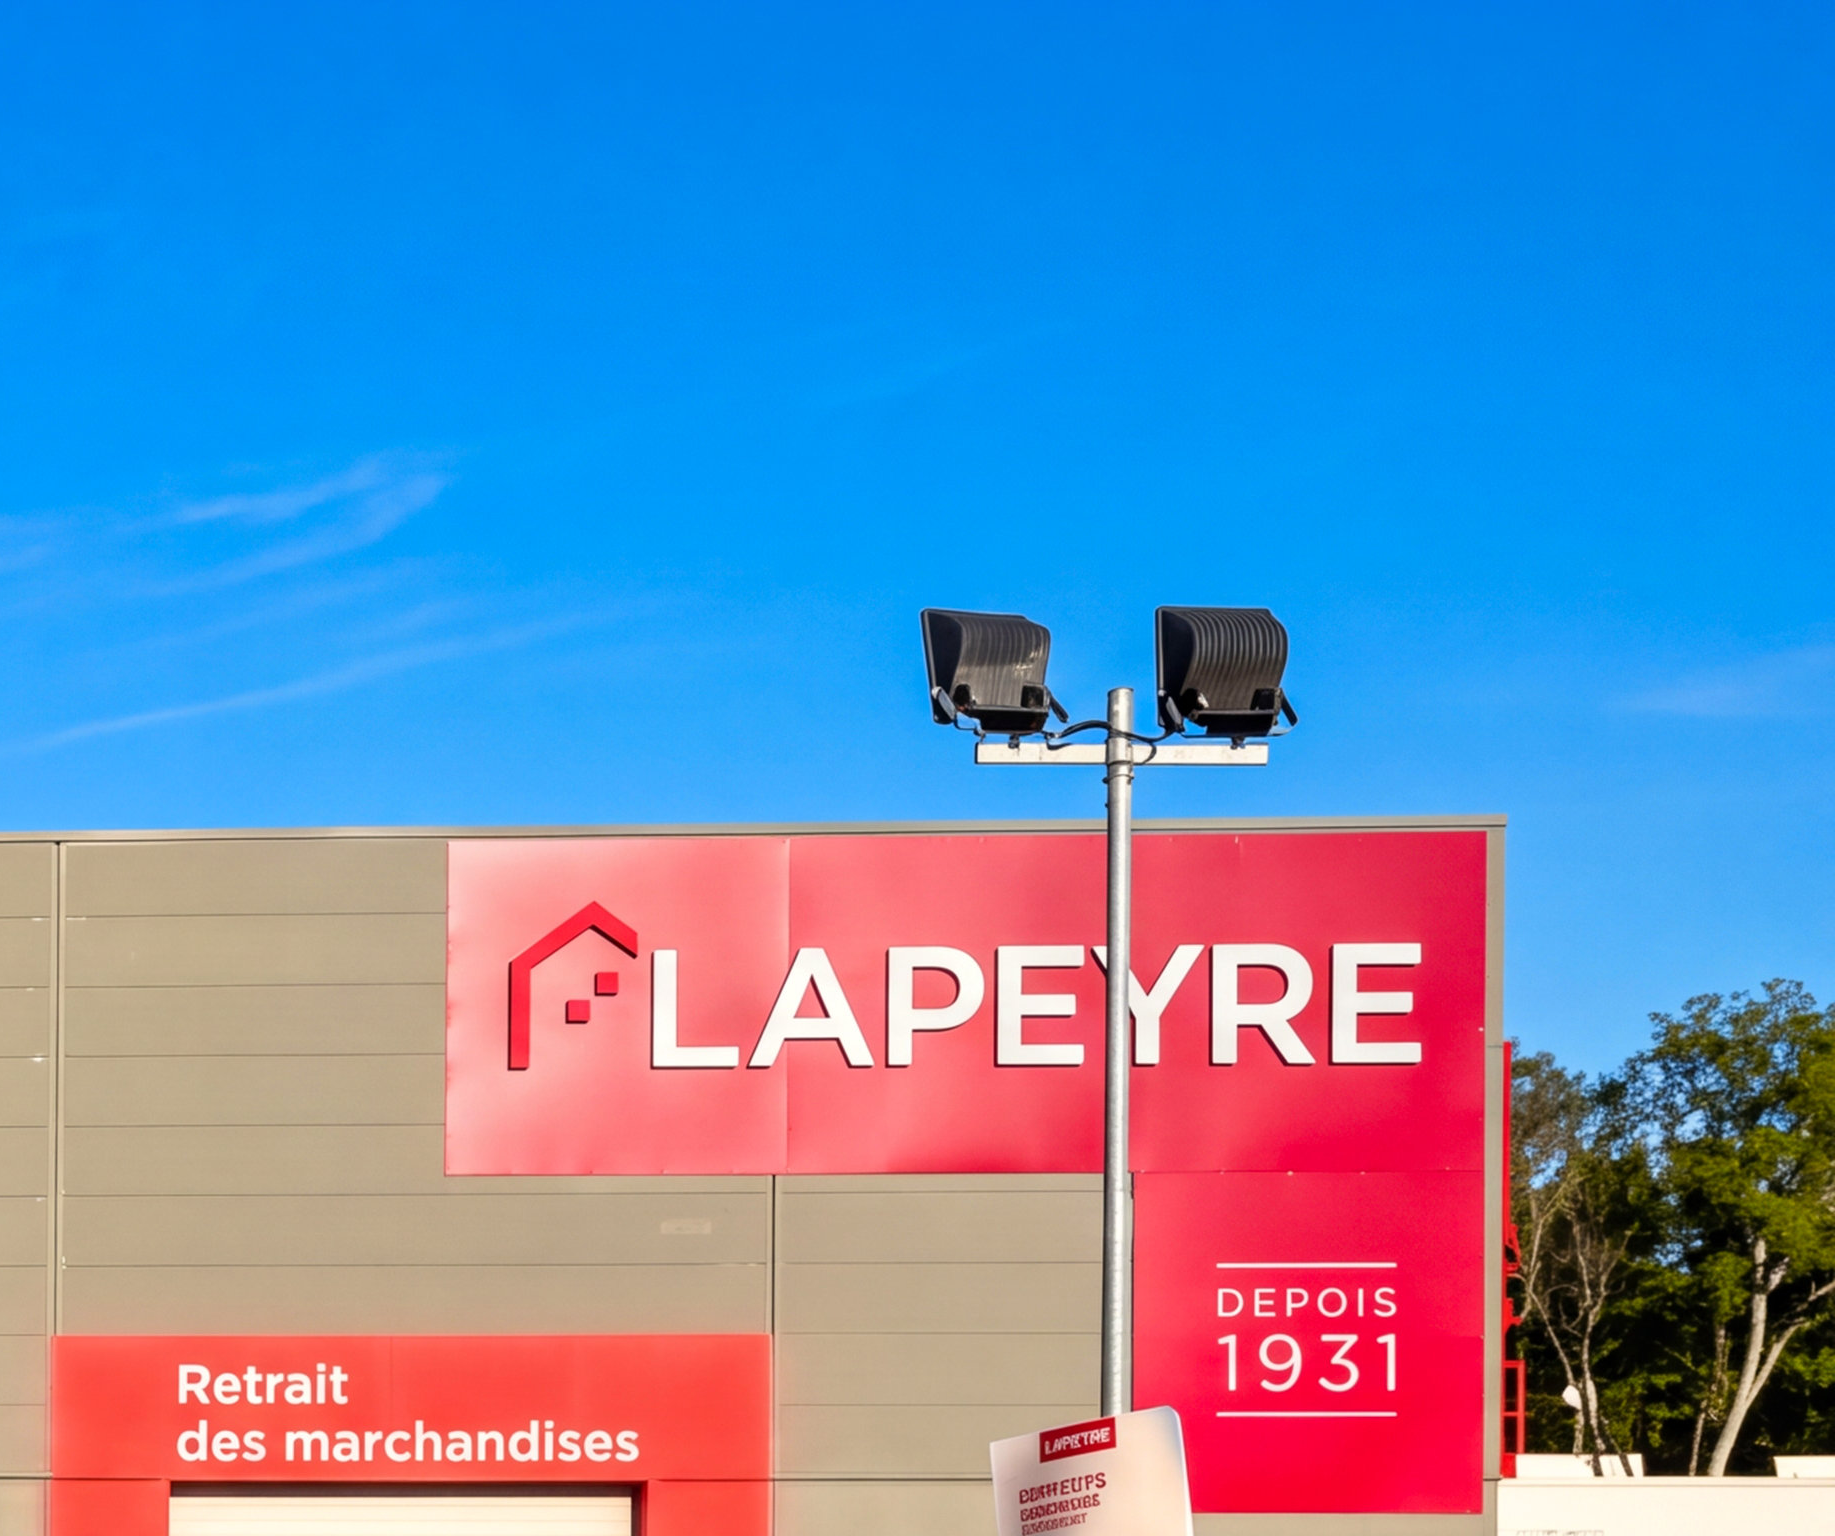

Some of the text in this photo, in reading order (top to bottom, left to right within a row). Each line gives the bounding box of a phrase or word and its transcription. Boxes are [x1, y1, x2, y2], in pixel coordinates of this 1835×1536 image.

[650, 943, 1422, 1068] LAPEYRE
[1216, 1287, 1397, 1318] DEPOIS
[177, 1362, 349, 1405] Retrait
[1217, 1333, 1396, 1392] 1931
[176, 1419, 640, 1463] des marchandises
